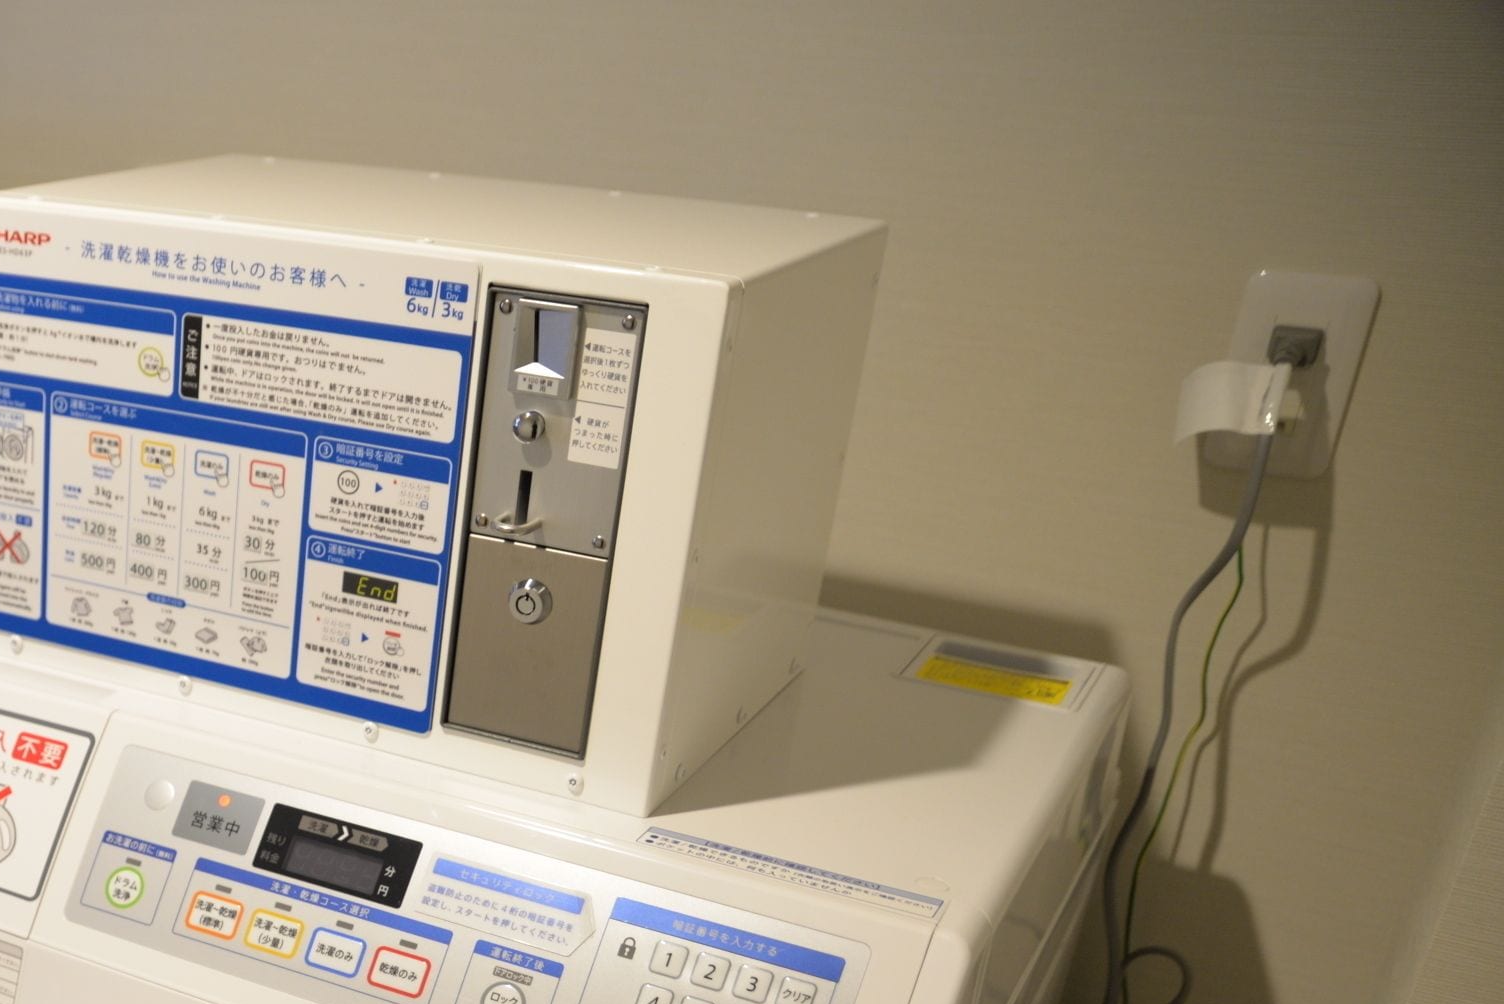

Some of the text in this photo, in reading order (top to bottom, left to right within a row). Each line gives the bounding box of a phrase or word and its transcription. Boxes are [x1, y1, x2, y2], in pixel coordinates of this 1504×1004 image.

[81, 240, 347, 289] 洗濯乾燥機をお使いのお客様へ
[152, 270, 166, 278] How
[189, 274, 200, 282] the
[202, 276, 230, 288] Washing
[232, 280, 260, 291] Machine
[408, 286, 429, 297] Wash
[446, 291, 459, 302] Dry
[406, 297, 428, 317] 6kg
[441, 302, 464, 321] 3kg
[212, 345, 227, 353] 100
[592, 343, 631, 357] 運転コースを
[581, 368, 628, 382] ゆっくり硬貨を
[580, 383, 626, 395] 入れてください
[587, 417, 609, 429] 硬貨が
[575, 427, 619, 442] つまった時に
[572, 439, 618, 453] 押してください
[336, 444, 404, 466] 暗証番号を設定
[340, 477, 356, 487] 100
[82, 520, 106, 536] 120
[135, 532, 152, 546] 80
[245, 536, 261, 550] 30
[196, 543, 209, 556] 35
[328, 543, 365, 560] 運転終了
[80, 552, 104, 568] 500
[130, 563, 153, 579] 400
[243, 566, 266, 582] 100
[184, 575, 207, 591] 300
[356, 576, 396, 601] End
[15, 734, 64, 766] 不要
[191, 811, 241, 837] 営業中
[307, 821, 329, 834] 洗濯
[106, 832, 155, 855] お洗濯の前に
[266, 832, 287, 846] 残り
[259, 850, 280, 865] 料金
[384, 865, 396, 878] 分
[114, 875, 138, 891] ドラム
[377, 884, 390, 897] 円
[112, 888, 131, 901] 洗浄
[270, 881, 371, 919] 洗濯・乾燥コース選択
[199, 915, 224, 930] (標準)
[257, 933, 284, 950] (少量)
[673, 920, 780, 957] 暗証番号を入力する
[316, 943, 354, 963] 洗濯のみ
[490, 947, 545, 971] 運転終了後
[378, 962, 418, 983] 乾燥のみ
[663, 952, 812, 1004] 1 2 3 クリア
